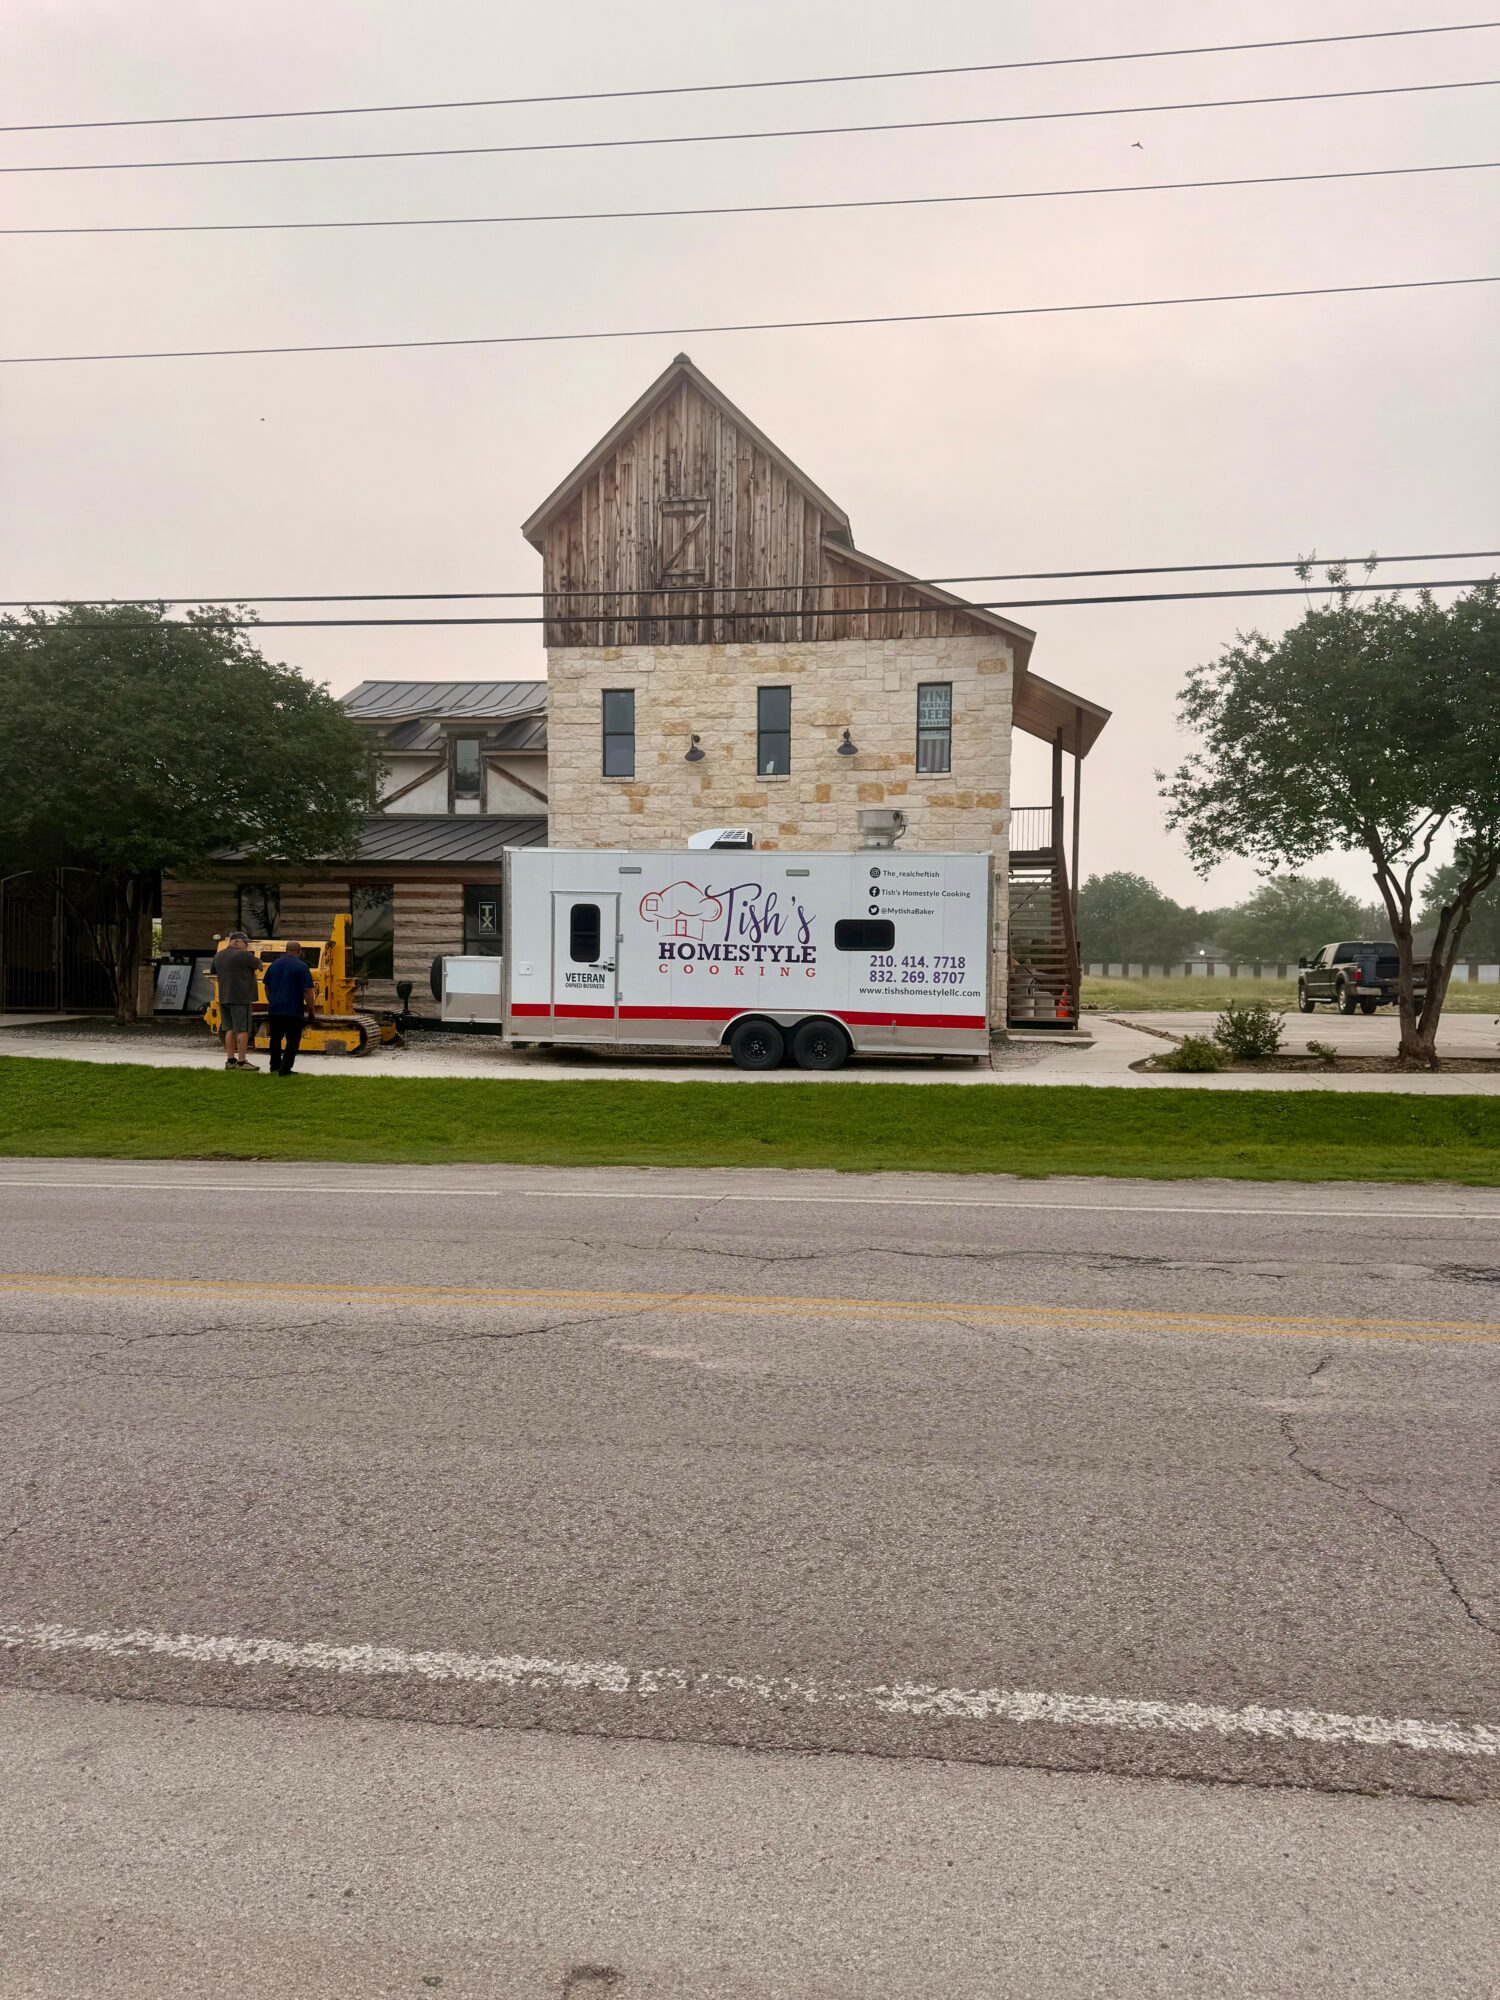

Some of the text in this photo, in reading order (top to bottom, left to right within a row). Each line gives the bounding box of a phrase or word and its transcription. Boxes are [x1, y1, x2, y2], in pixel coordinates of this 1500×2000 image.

[920, 691, 950, 702] WINE
[919, 709, 950, 720] BEER
[902, 889, 940, 897] Homestyle
[941, 890, 971, 898] Cooking
[705, 883, 817, 945] Tish's
[881, 907, 935, 915] @MytishaBaker
[658, 942, 817, 964] HOMESTYLE
[870, 955, 966, 969] 210. 414. 7718
[658, 963, 817, 978] COOKING
[565, 972, 606, 983] VETERAN
[869, 970, 966, 984] 832. 269. 8707
[859, 987, 981, 997] www.tishshomestylellc.com
